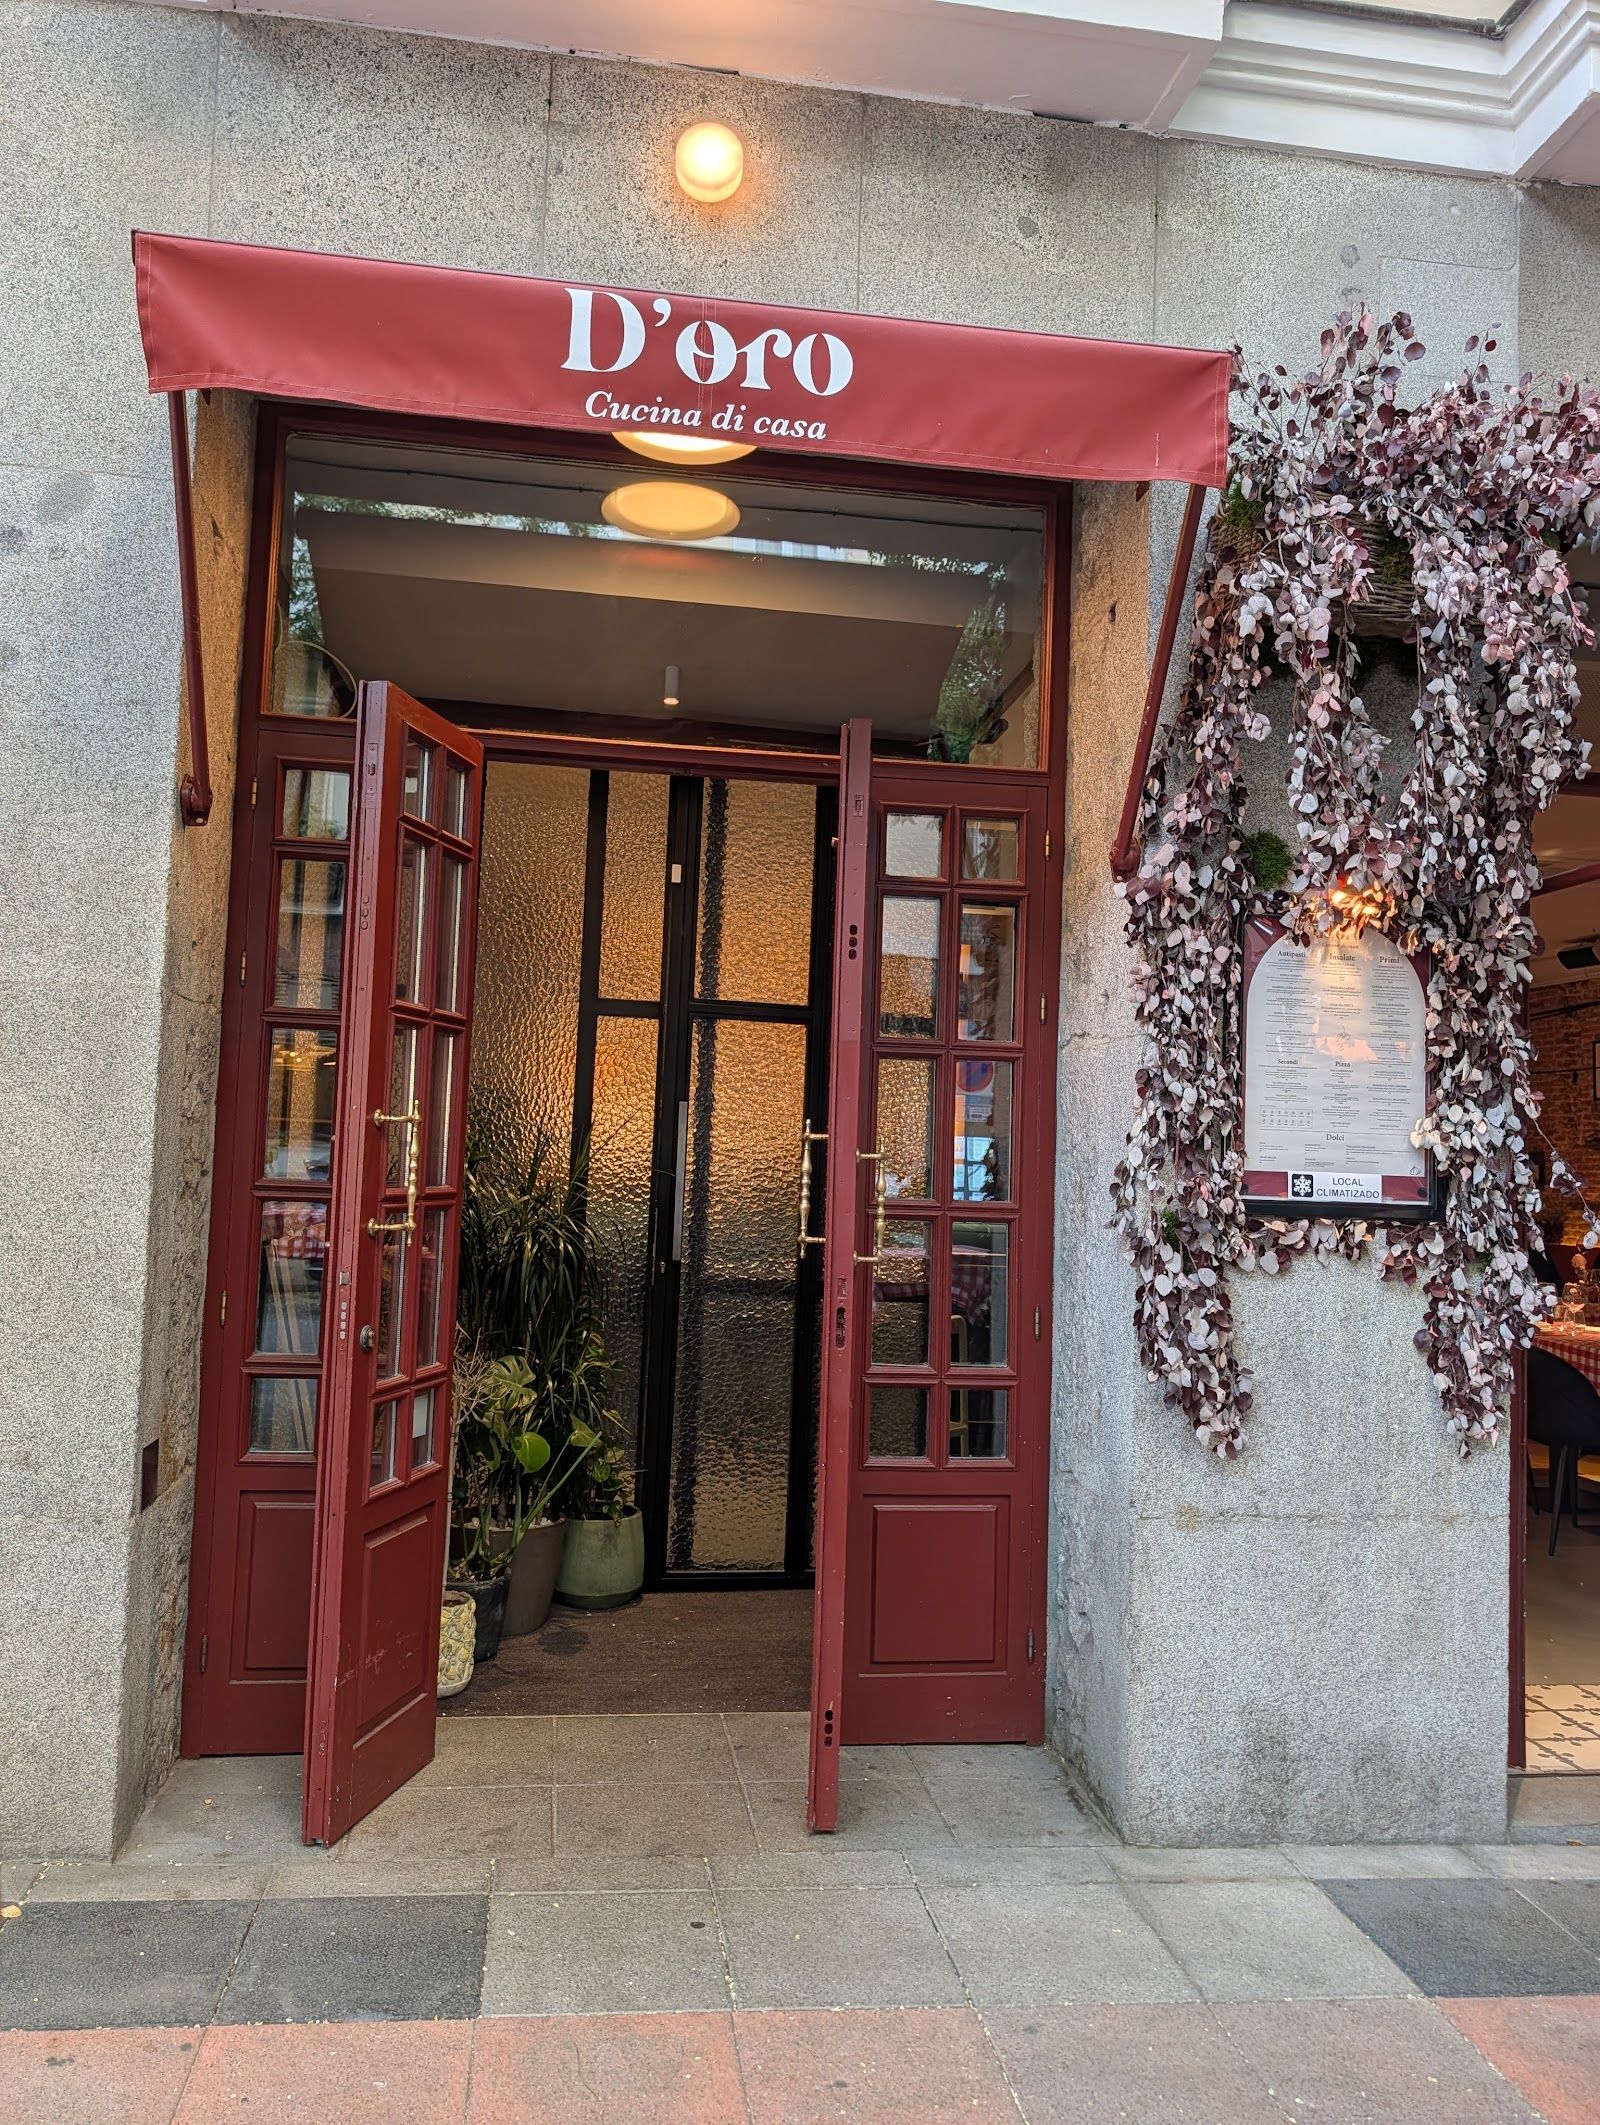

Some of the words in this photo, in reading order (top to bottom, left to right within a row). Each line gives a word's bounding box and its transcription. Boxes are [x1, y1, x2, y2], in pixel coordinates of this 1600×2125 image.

[585, 390, 702, 427] Cucina
[711, 403, 747, 432] di
[753, 415, 828, 440] casa
[1277, 950, 1306, 959] Antipasti
[1329, 952, 1356, 962] Insalate
[1379, 955, 1400, 964] Primi
[1335, 1060, 1351, 1068] Pizza
[1326, 1133, 1345, 1142] Dolci
[1332, 1177, 1364, 1186] LOCAL
[1316, 1188, 1380, 1199] CLIMATIZADO
